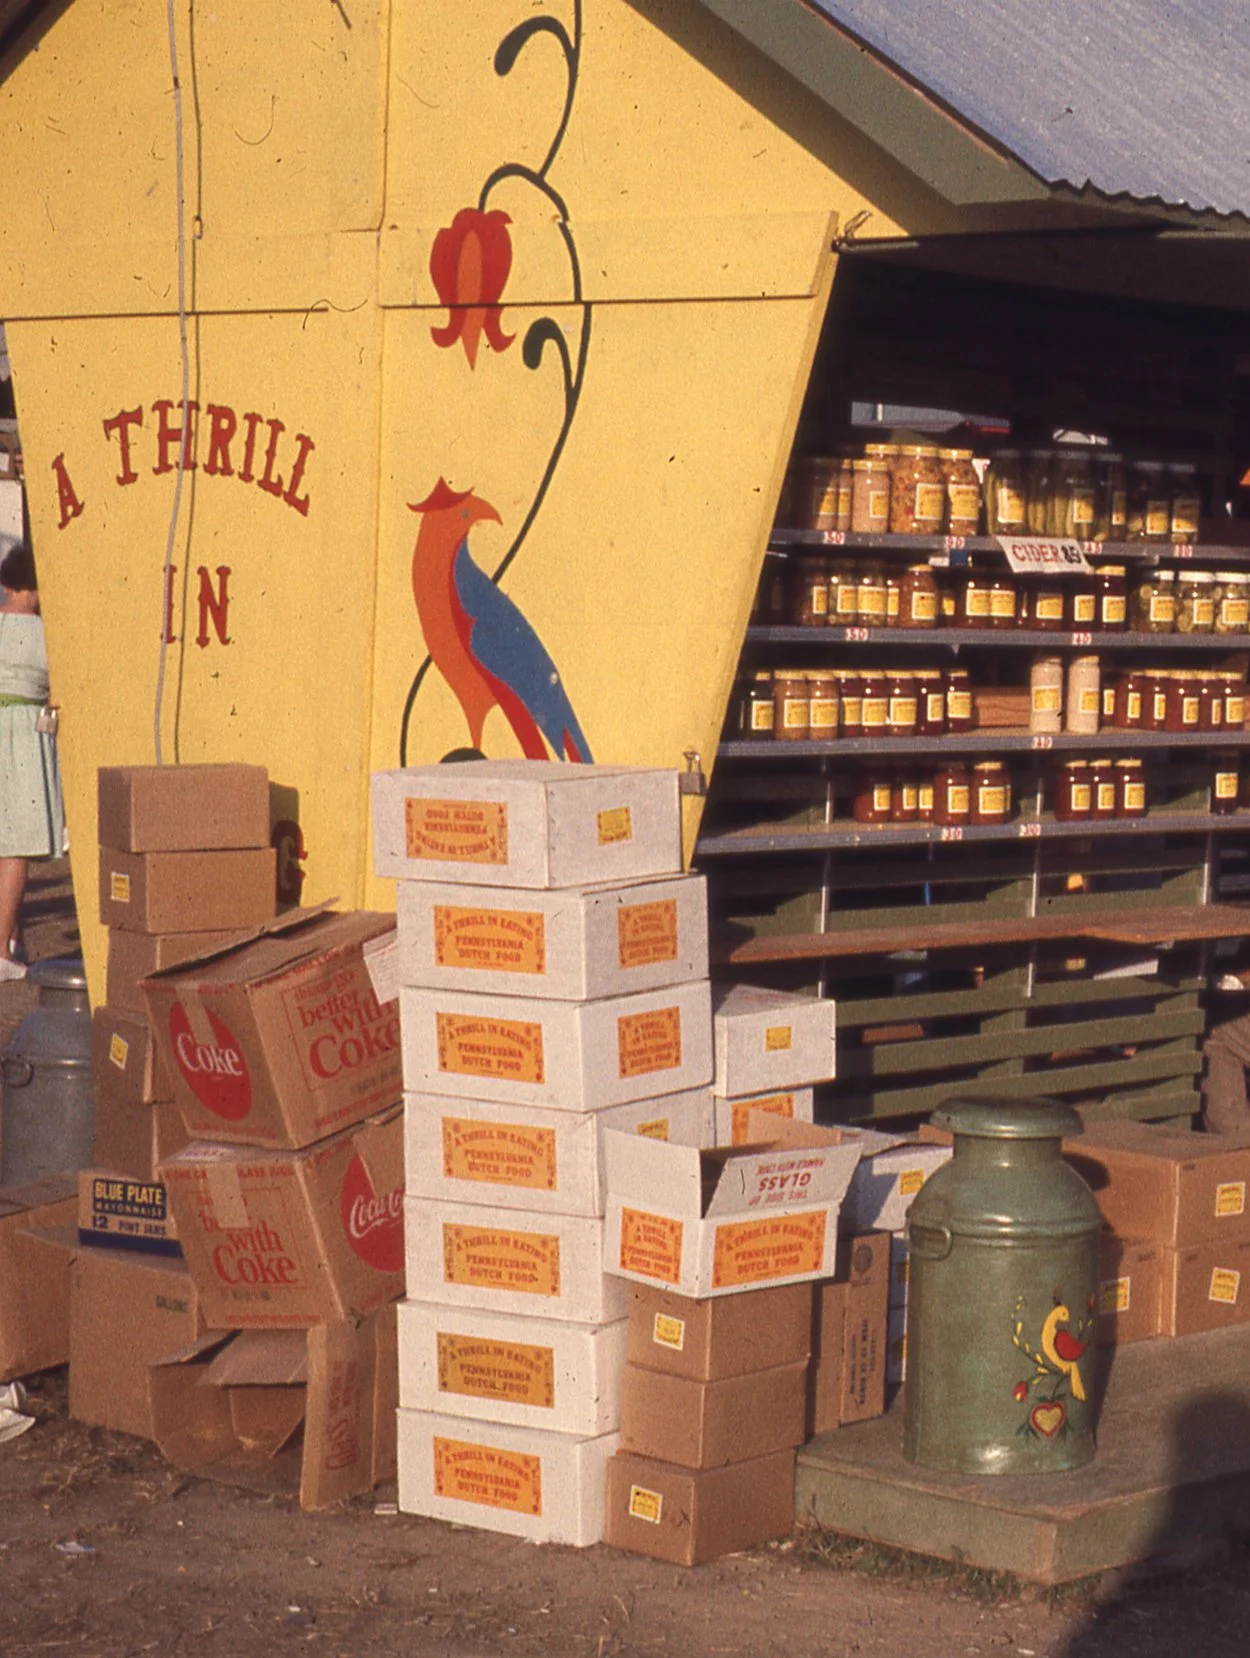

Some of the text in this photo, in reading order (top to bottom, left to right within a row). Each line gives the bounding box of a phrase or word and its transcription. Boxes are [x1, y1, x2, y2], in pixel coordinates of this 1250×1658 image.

[52, 400, 315, 530] A THRILL
[1011, 544, 1062, 563] CIDER
[161, 564, 232, 648] IN
[177, 1031, 243, 1076] Coke
[309, 1018, 399, 1079] Coke
[461, 1130, 494, 1142] THRILL
[465, 1149, 534, 1166] PENNSYLVANIA
[468, 1161, 532, 1178] DUTCH FOOD
[758, 1173, 811, 1192] GLASS
[95, 1181, 163, 1205] BLUE PLATE
[95, 1201, 164, 1217] MAYONNAISE
[93, 1215, 109, 1229] 12
[226, 1220, 284, 1252] with
[463, 1235, 497, 1248] THRILL
[734, 1227, 768, 1248] THRILL
[735, 1242, 804, 1262] PENNSYLVANIA
[213, 1246, 298, 1285] Coke
[466, 1254, 538, 1271] PENNSYLVANIA
[737, 1254, 800, 1275] DUTCH FOOD
[470, 1267, 535, 1283] DUTCH FOOD
[458, 1345, 490, 1357] THRILL
[460, 1363, 532, 1381] PENNSYLVANIA
[463, 1375, 529, 1395] DUTCH FOOD
[452, 1451, 483, 1461] THRILL
[455, 1467, 521, 1489] PENNSYLVANIA
[457, 1480, 518, 1502] DUTCH FOOD
